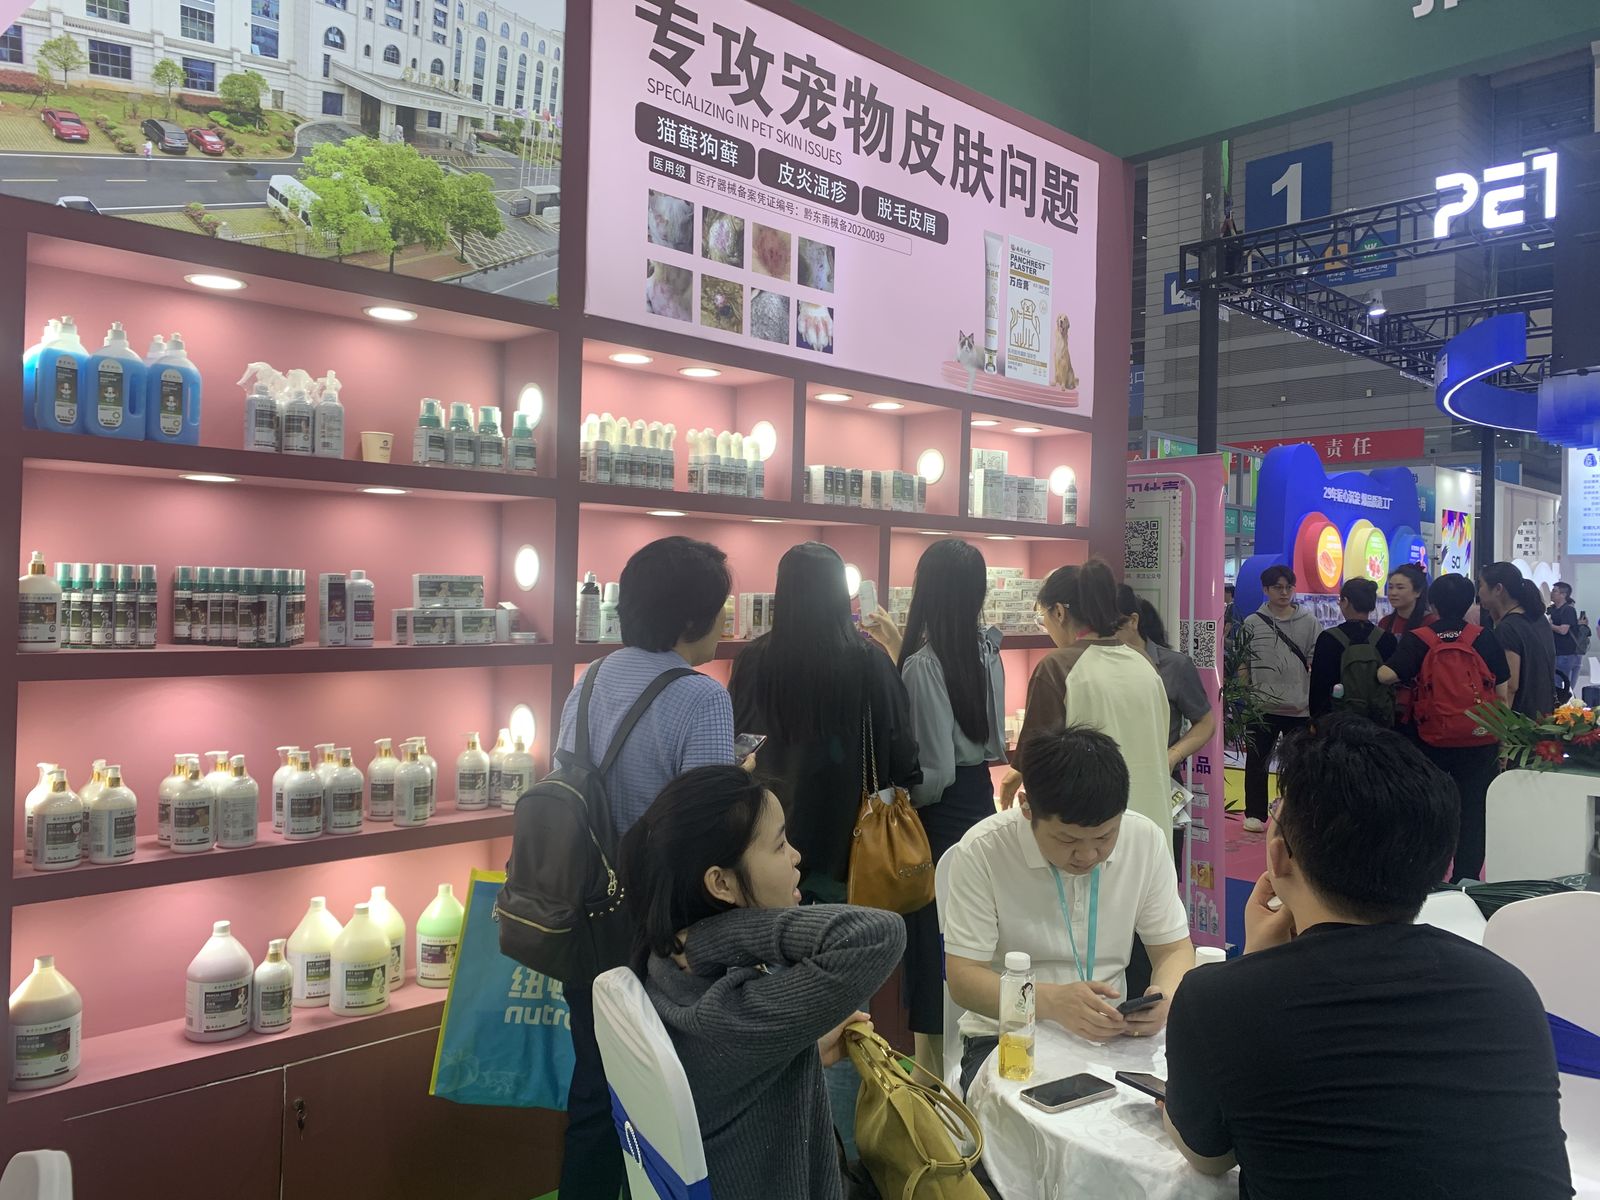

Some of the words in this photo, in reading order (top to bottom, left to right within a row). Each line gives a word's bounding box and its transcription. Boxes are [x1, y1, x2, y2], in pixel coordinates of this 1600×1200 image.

[635, 0, 1080, 234] 专攻宠物皮肤问题
[647, 78, 734, 124] SPECIALIZING
[737, 112, 749, 130] IN
[752, 117, 774, 140] PET
[776, 128, 802, 151] SKIN
[804, 140, 843, 166] ISSUES
[656, 115, 739, 168] 猫藓狗藓
[652, 156, 686, 179] 医用级
[777, 162, 847, 204] 皮炎湿疹
[1271, 162, 1303, 226] 1
[877, 196, 937, 236] 脱毛皮屑
[1010, 253, 1046, 271] PANCHREST
[1010, 261, 1037, 276] PLASTER
[1010, 276, 1029, 291] 万应膏
